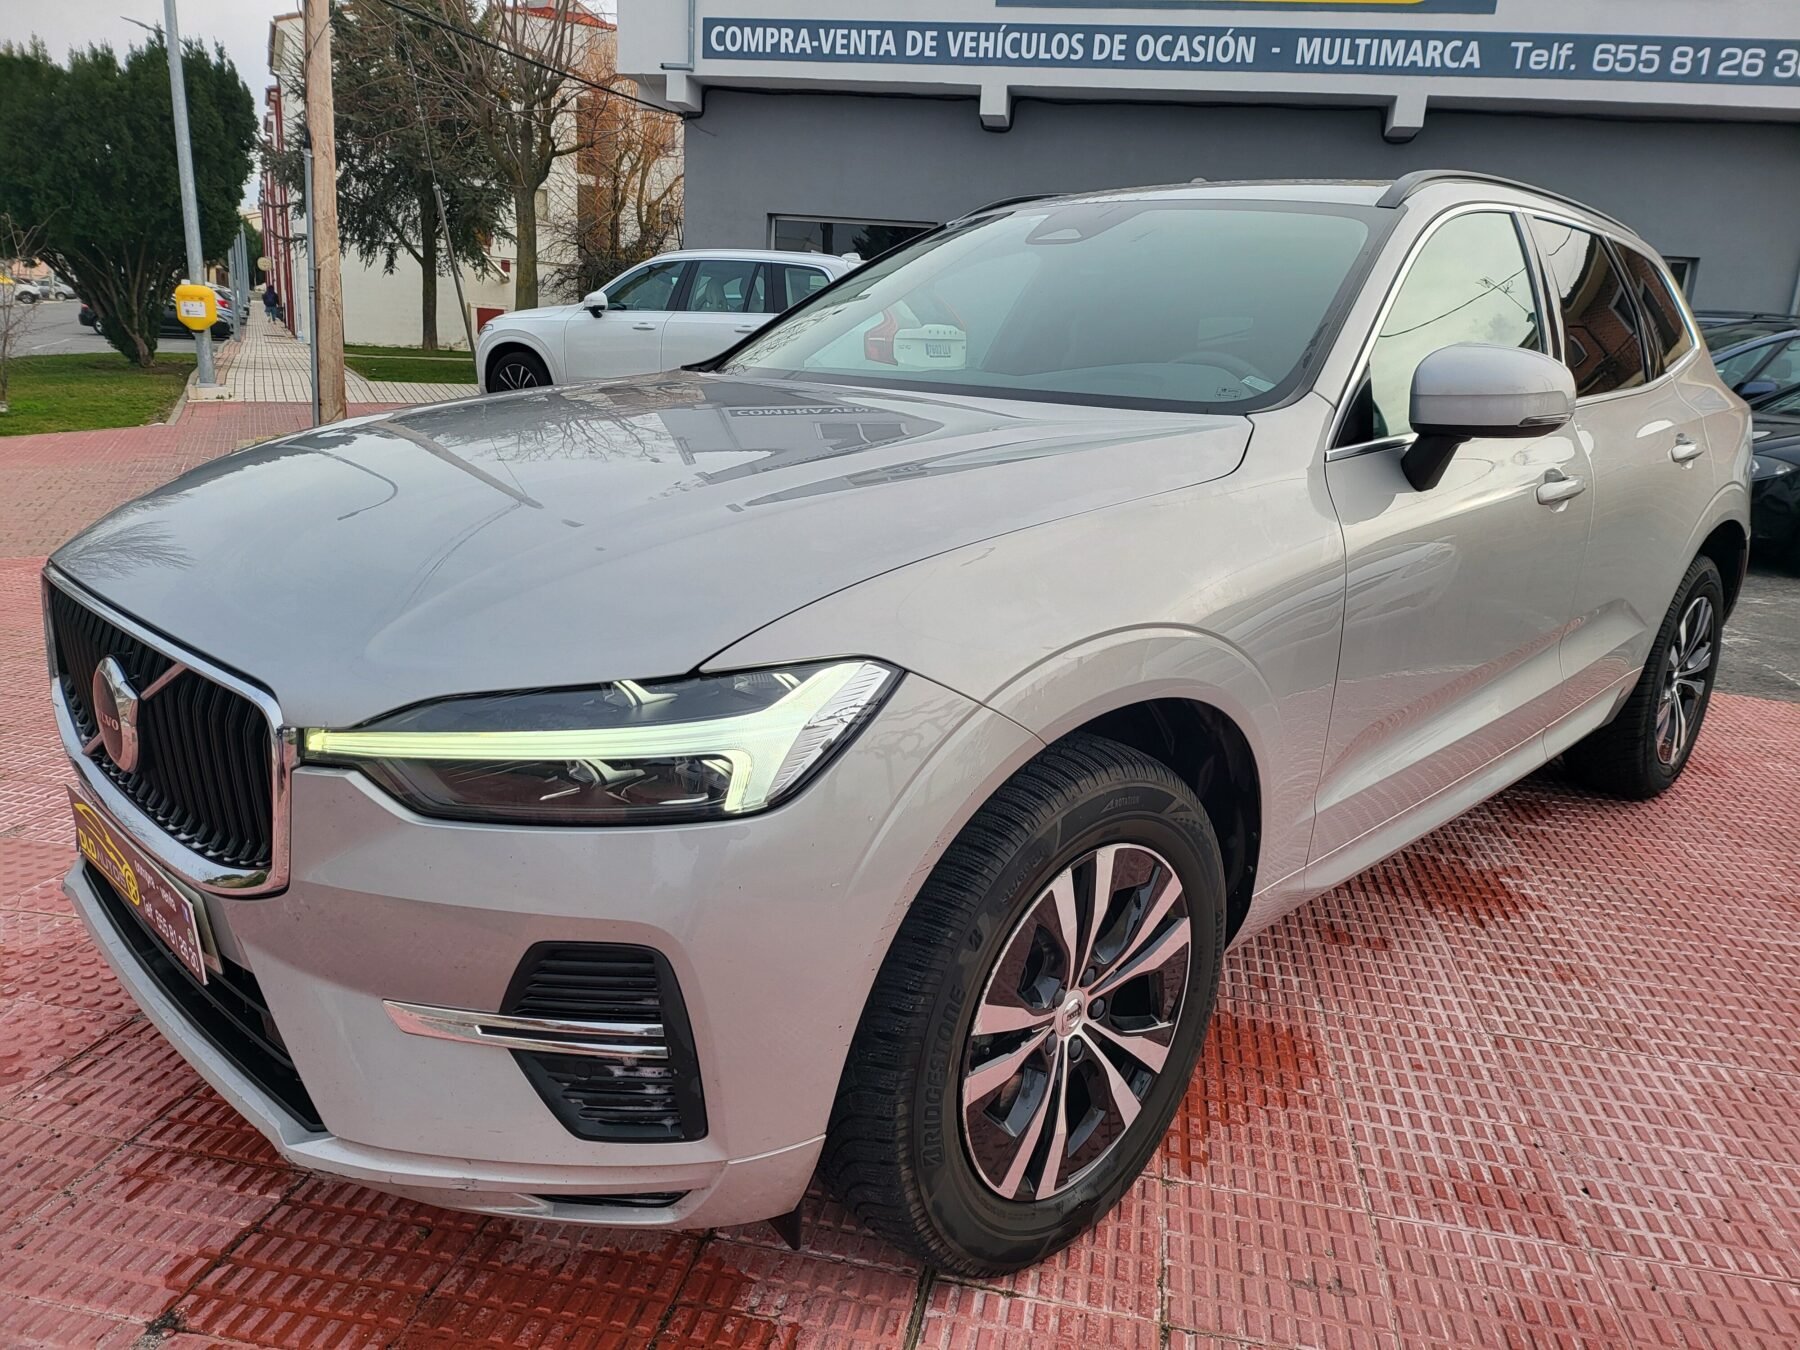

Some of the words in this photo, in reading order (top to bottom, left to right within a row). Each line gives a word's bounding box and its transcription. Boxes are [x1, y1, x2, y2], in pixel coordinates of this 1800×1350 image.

[710, 25, 897, 56] COMPRA-VENTA
[906, 30, 938, 57] DE
[947, 25, 1084, 60] VEHÍCULOS
[1093, 34, 1127, 61] DE
[1136, 28, 1257, 64] OCASIÓN
[1295, 37, 1482, 70] MULTIMARCA
[1510, 41, 1577, 71] Telf.
[1592, 43, 1661, 74] 655
[1773, 48, 1800, 78] 3
